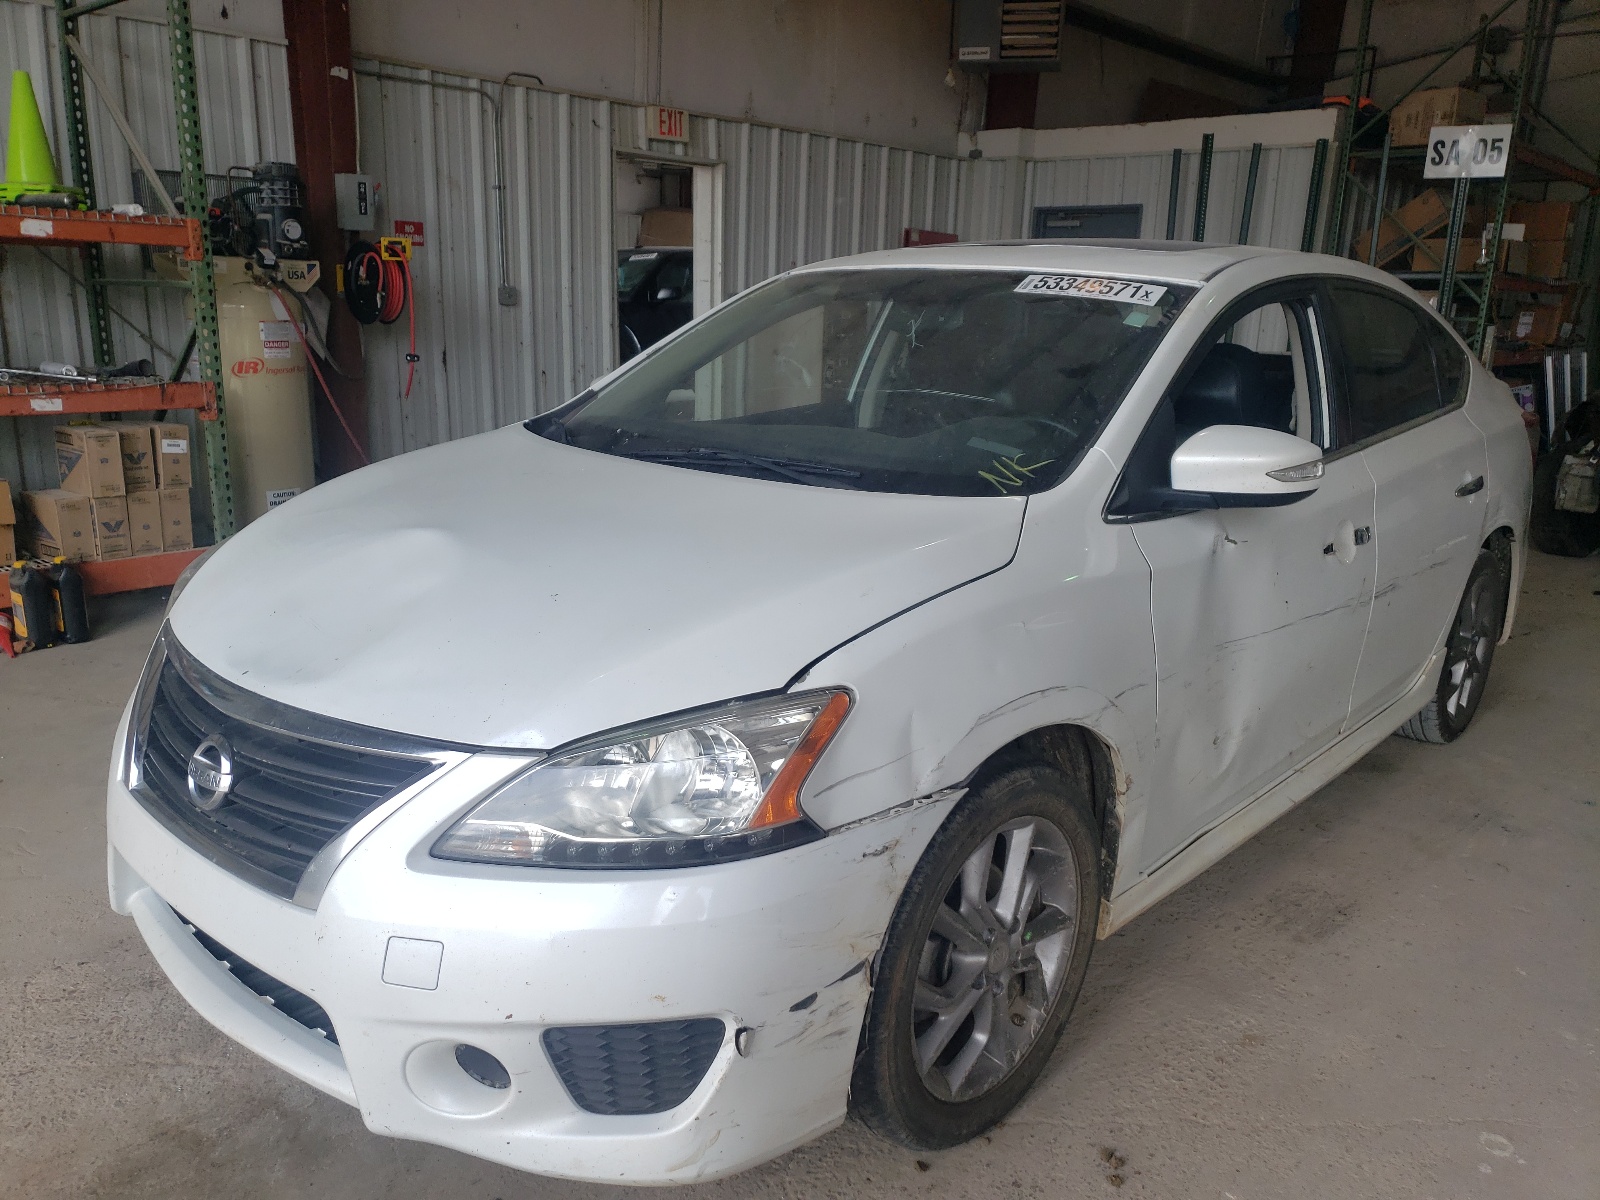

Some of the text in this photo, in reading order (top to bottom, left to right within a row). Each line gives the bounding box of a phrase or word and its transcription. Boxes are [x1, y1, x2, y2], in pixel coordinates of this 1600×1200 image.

[659, 108, 684, 137] EXIT
[404, 224, 415, 233] NO
[287, 270, 306, 280] USA
